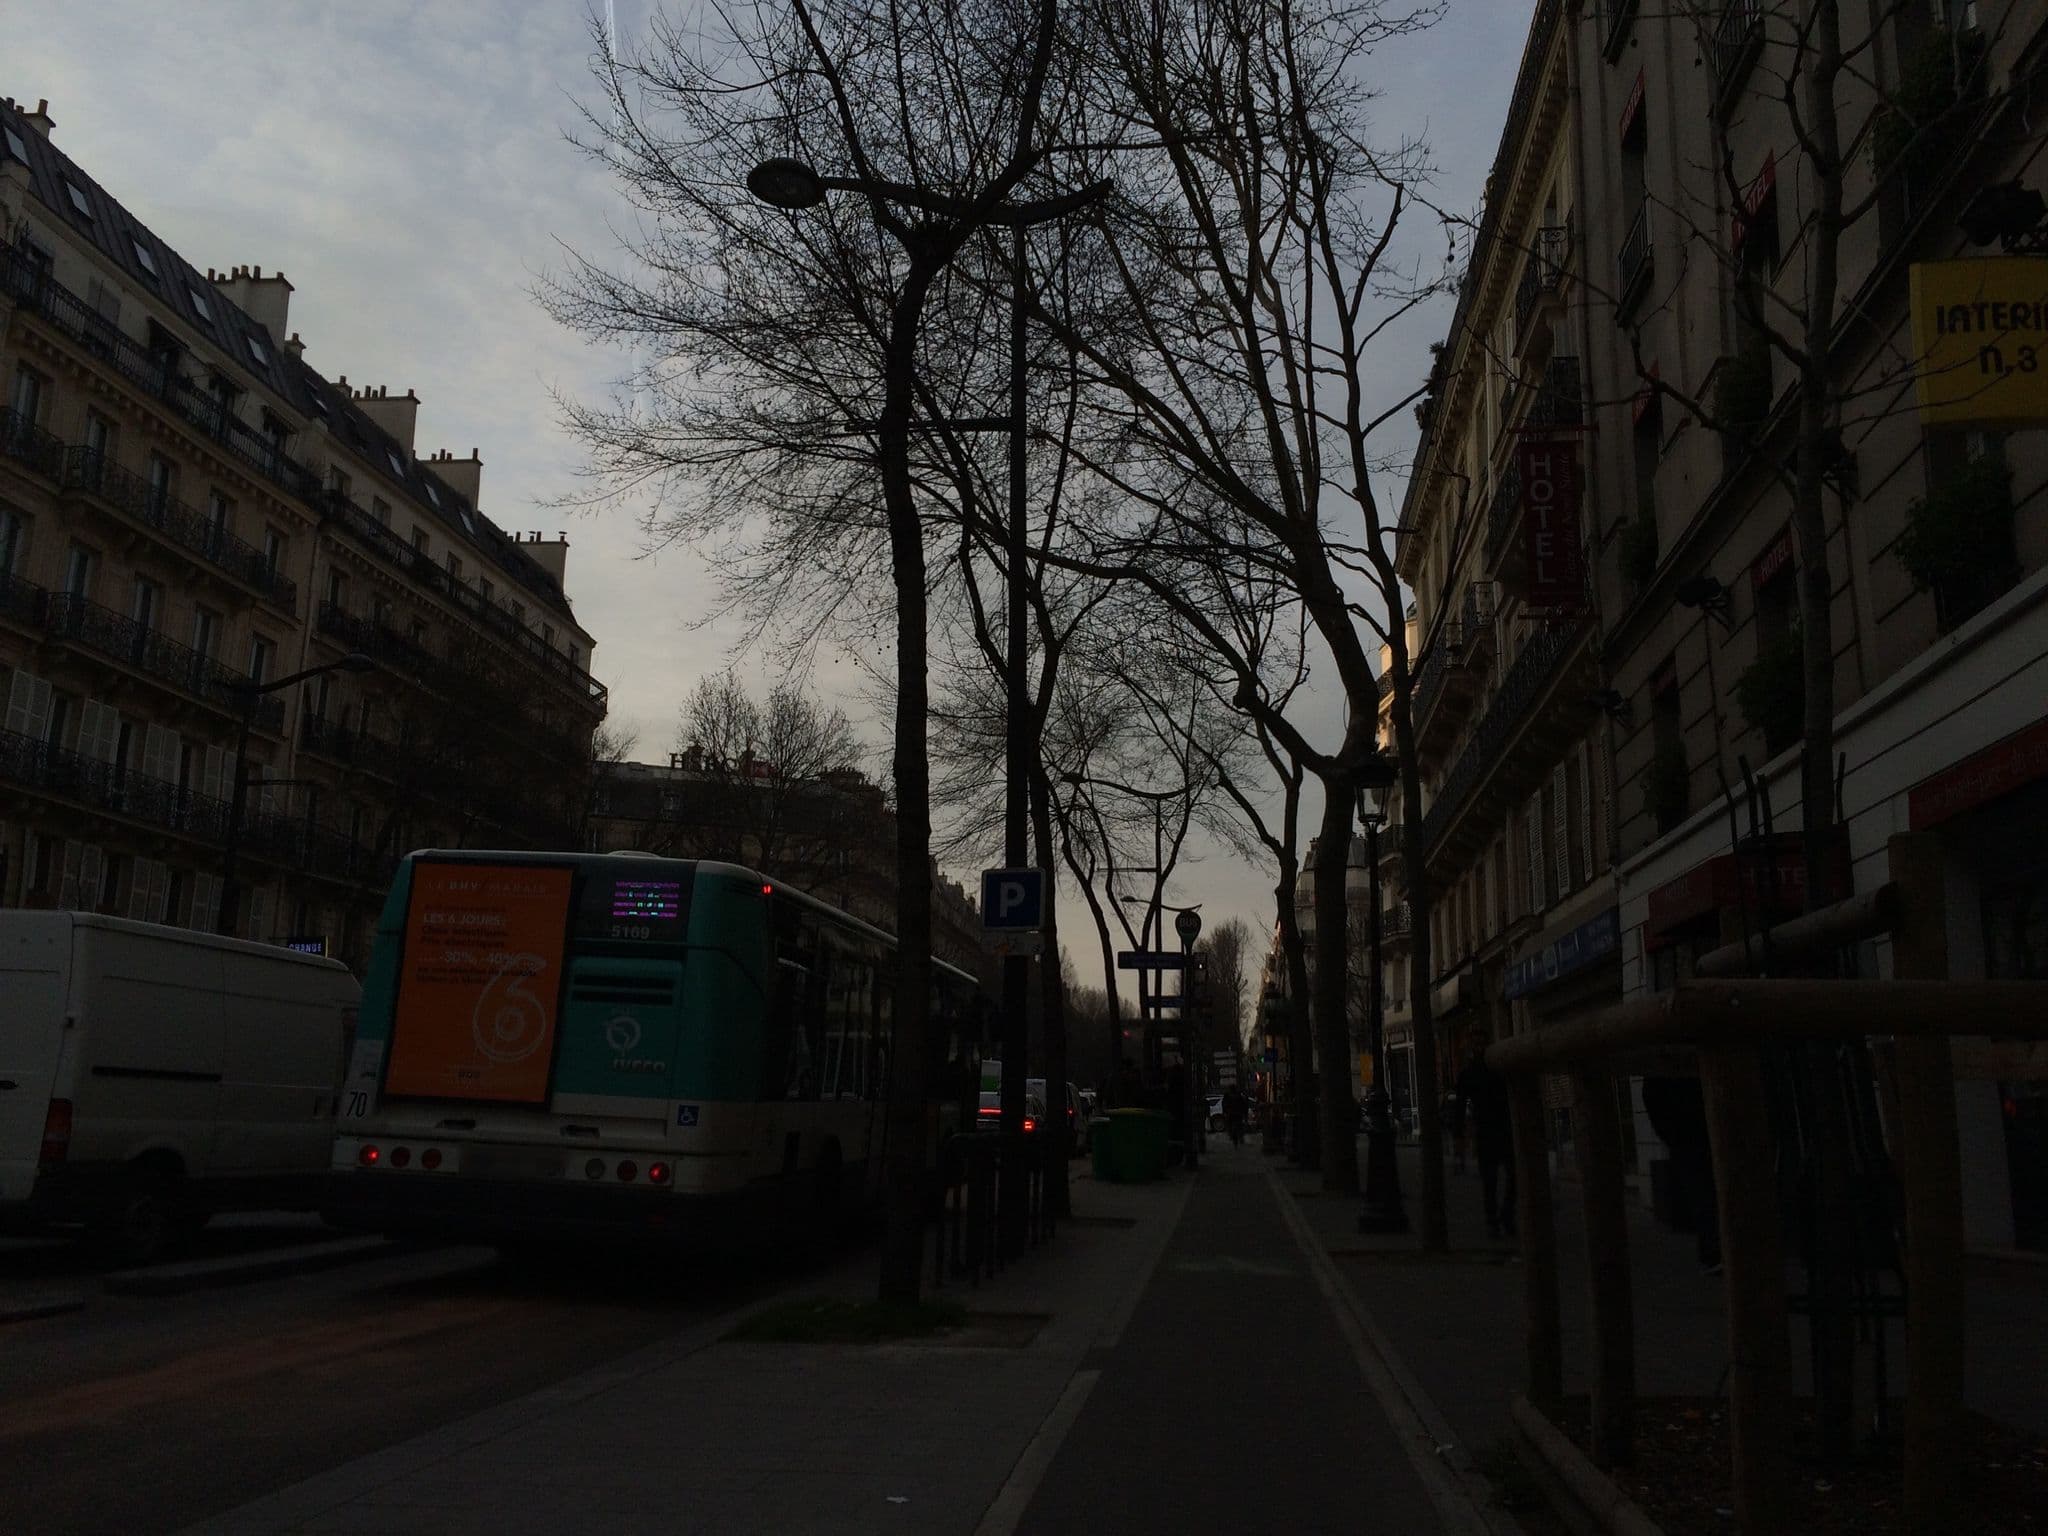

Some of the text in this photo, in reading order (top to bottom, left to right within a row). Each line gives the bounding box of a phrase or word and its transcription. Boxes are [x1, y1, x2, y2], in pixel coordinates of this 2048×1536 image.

[1936, 301, 2048, 334] INTERI
[1529, 453, 1557, 583] HOTEL
[1760, 542, 1789, 581] HOTEL
[999, 881, 1026, 918] P
[423, 912, 442, 923] LES
[1179, 917, 1198, 927] BUS
[346, 1091, 368, 1118] 70
